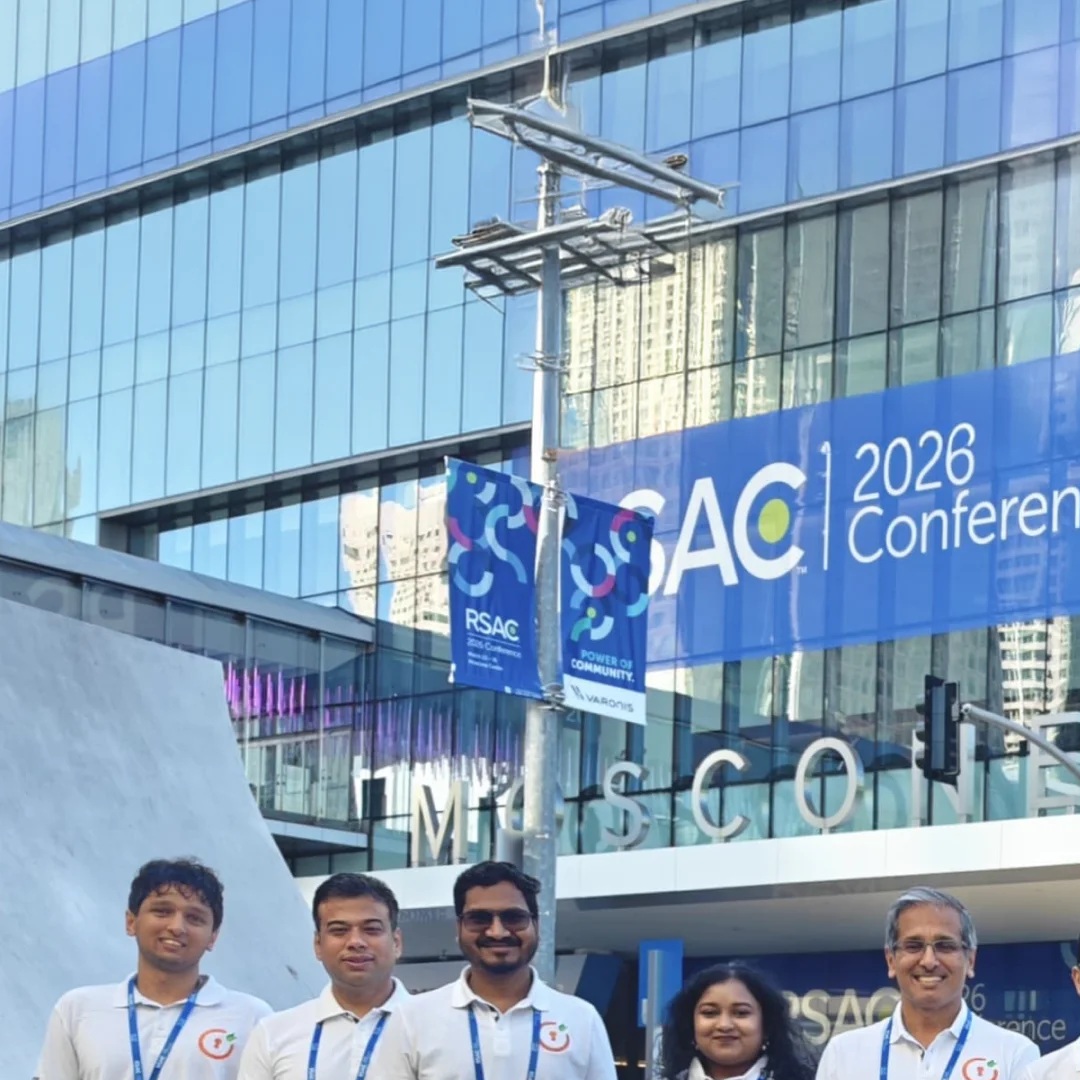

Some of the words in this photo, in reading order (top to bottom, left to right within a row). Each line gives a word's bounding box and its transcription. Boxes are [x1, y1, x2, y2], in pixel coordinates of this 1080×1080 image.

[853, 422, 976, 503] 2026
[618, 461, 807, 596] SAC
[465, 607, 520, 642] RSAC
[580, 649, 618, 668] POWER
[620, 659, 633, 671] OF
